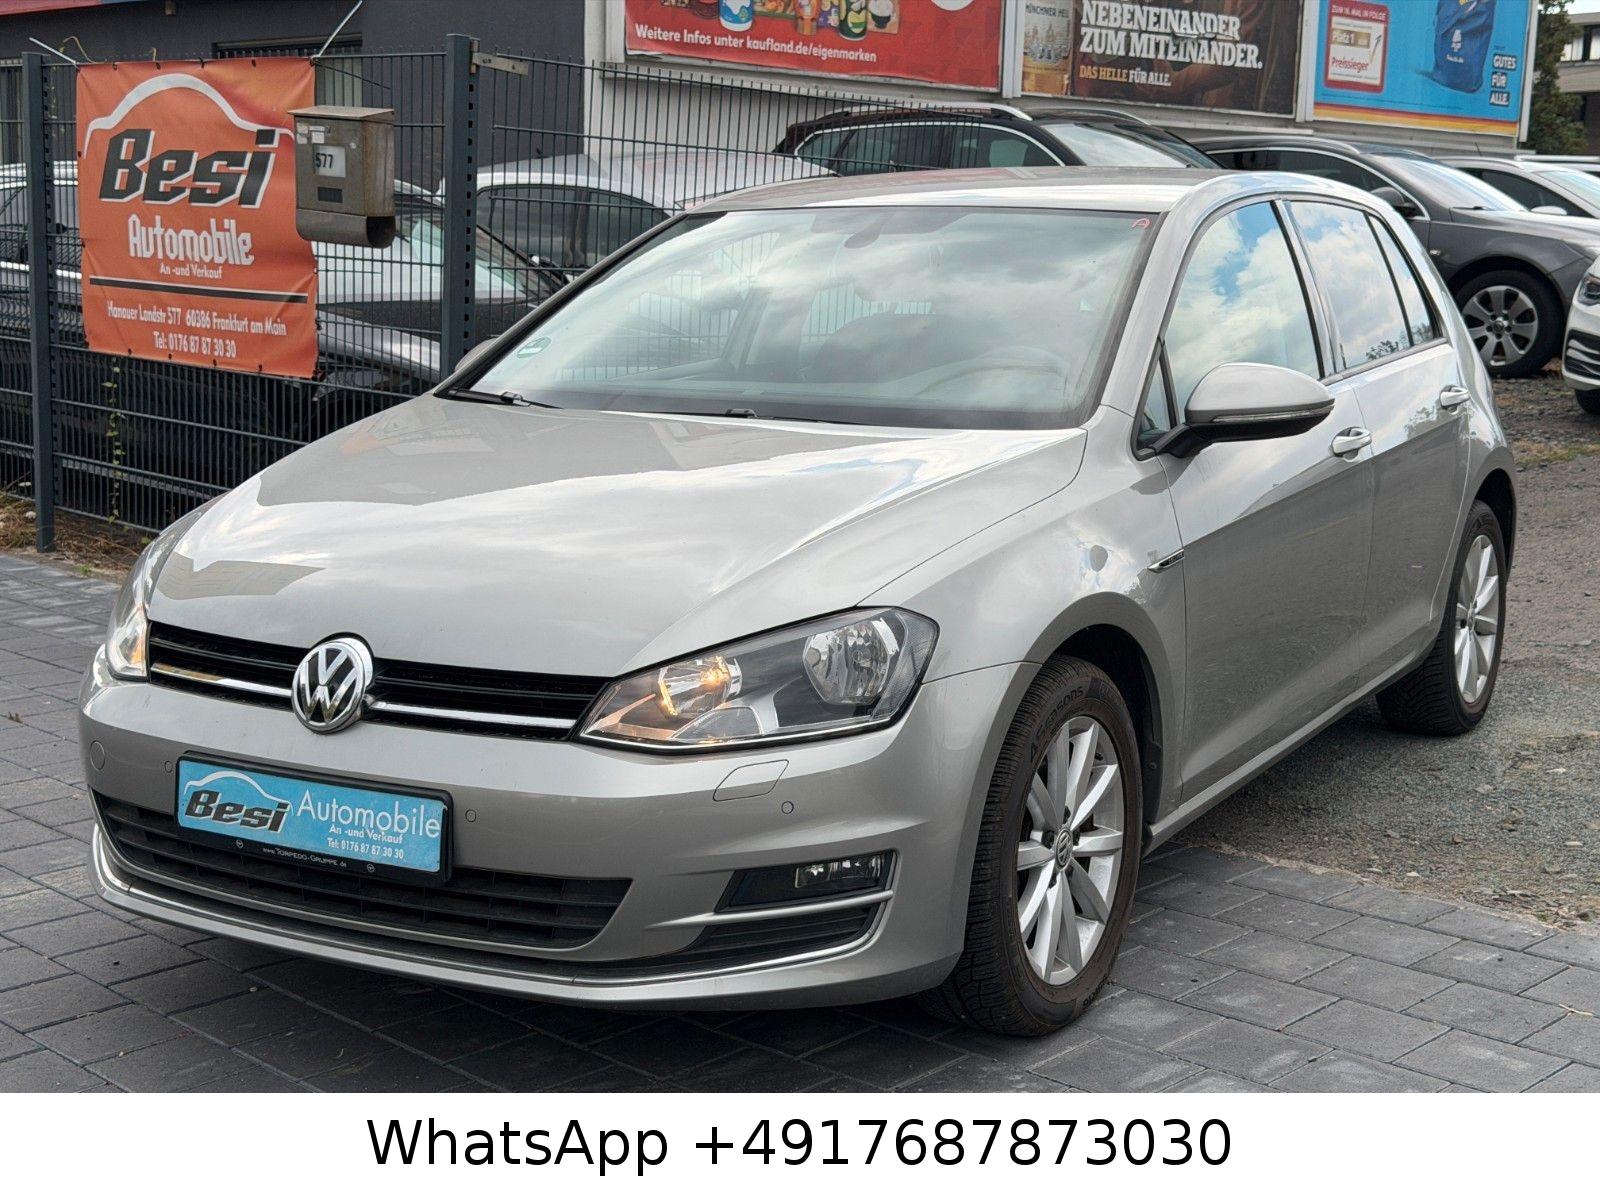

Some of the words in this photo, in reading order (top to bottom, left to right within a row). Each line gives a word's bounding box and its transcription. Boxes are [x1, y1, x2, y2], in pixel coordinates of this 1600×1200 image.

[1080, 0, 1242, 42] NEBENEINANDER
[634, 23, 680, 43] Weitere
[683, 29, 712, 46] Infos
[714, 35, 744, 49] unter
[746, 37, 877, 63] kaufland.de/eigenmarken
[1079, 27, 1126, 57] ZUM
[1129, 32, 1263, 70] MITEINANDER.
[1079, 64, 1100, 80] DAS
[1100, 66, 1128, 83] HELLE
[1128, 66, 1147, 85] FÜR
[1331, 56, 1369, 74] Preissieger
[1493, 55, 1516, 69] GUTES
[1491, 72, 1507, 88] FÜR
[99, 128, 279, 209] Besi
[315, 152, 334, 169] 577
[128, 213, 255, 266] Automobile
[160, 262, 171, 275] An
[172, 263, 190, 277] -und
[190, 264, 223, 279] Verkauf
[107, 300, 138, 320] Hanauer
[139, 304, 166, 324] Landstr
[167, 306, 182, 326] 577
[185, 308, 211, 330] 60386
[212, 312, 249, 334] Frankfurt
[250, 320, 263, 335] am
[264, 316, 287, 337] Main
[153, 330, 168, 350] Tel:
[168, 332, 189, 352] 0176
[190, 336, 200, 355] 87
[201, 337, 212, 356] 87
[213, 339, 225, 358] 30
[226, 340, 237, 359] 30
[294, 642, 364, 730] VW
[184, 788, 292, 834] Besi
[296, 788, 441, 839] Automobile
[327, 837, 340, 849] Tel:
[341, 839, 359, 853] 0176
[360, 842, 370, 855] 87
[371, 844, 380, 856] 87
[382, 846, 393, 858] 30
[394, 848, 404, 860] 30
[329, 823, 342, 835] An
[344, 828, 365, 839] -und
[366, 828, 404, 845] Verkauf
